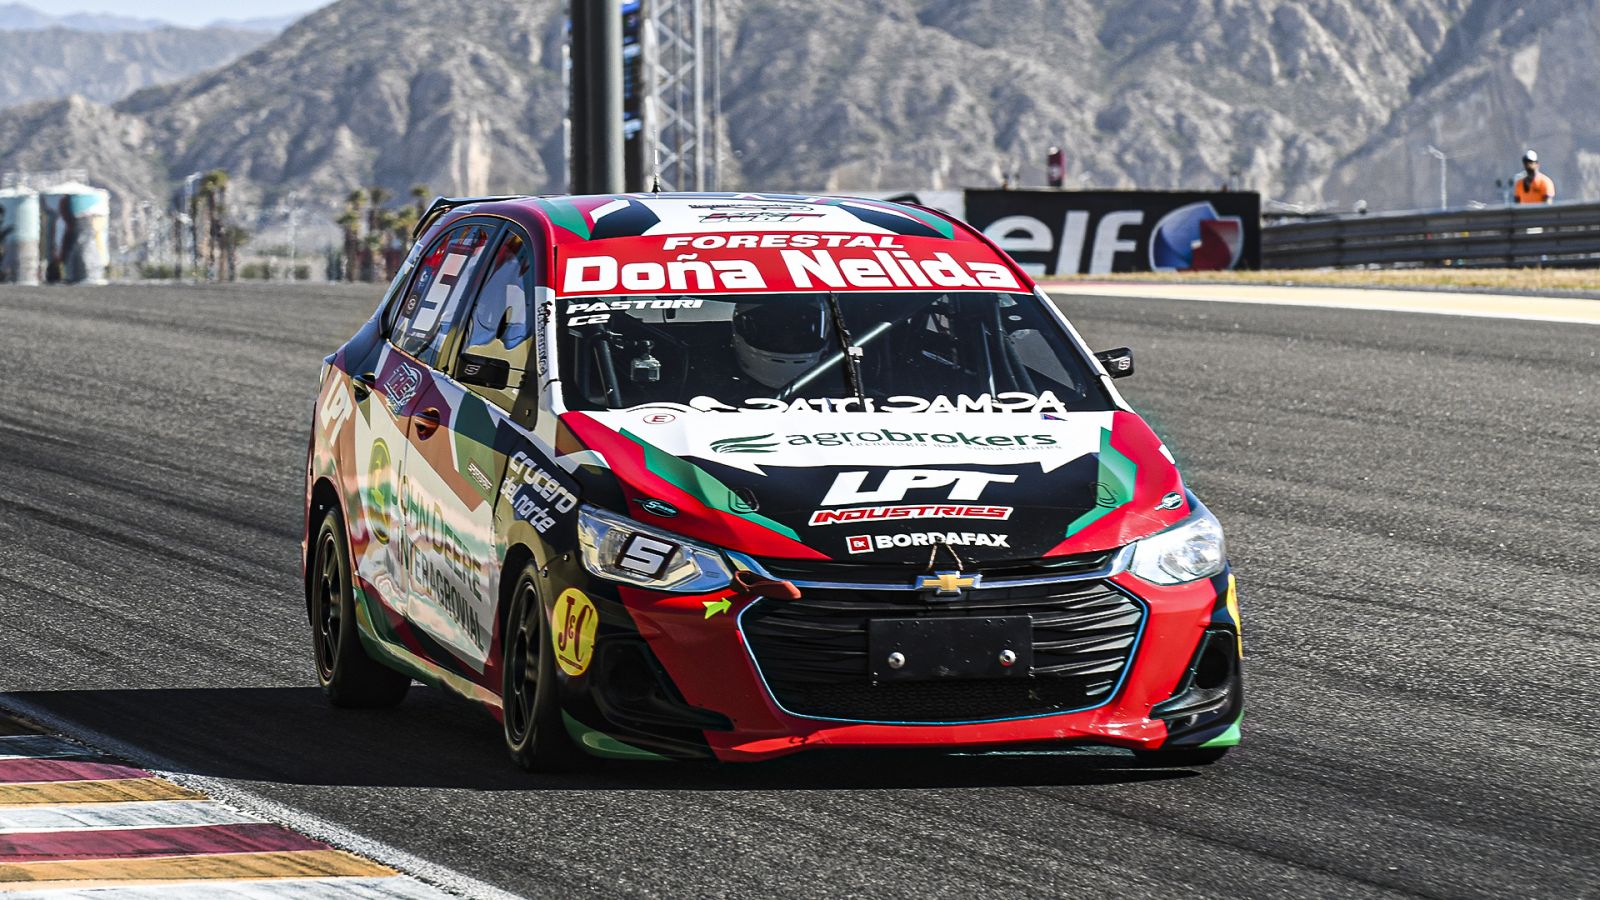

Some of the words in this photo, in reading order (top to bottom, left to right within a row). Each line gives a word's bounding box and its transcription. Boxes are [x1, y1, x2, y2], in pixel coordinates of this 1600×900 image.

[663, 234, 905, 251] FORESTAL
[984, 210, 1145, 275] elf
[411, 252, 468, 332] 5
[562, 253, 768, 294] Doña
[780, 249, 1021, 293] Nelida
[566, 299, 704, 315] PASTORI
[567, 314, 611, 327] C2
[320, 373, 353, 447] LPT
[785, 428, 1059, 447] agrobrokers
[510, 451, 578, 514] crucero
[820, 469, 1019, 506] LPT
[500, 477, 523, 505] del
[514, 494, 557, 534] norte
[811, 505, 1010, 525] INDUSTRIES
[391, 460, 430, 544] JOHN
[432, 500, 483, 603] DEERE
[874, 532, 1011, 549] BORDAFAX
[620, 535, 674, 575] 5
[396, 526, 486, 652] INTERAGROVIAL
[558, 595, 594, 662] J&C
